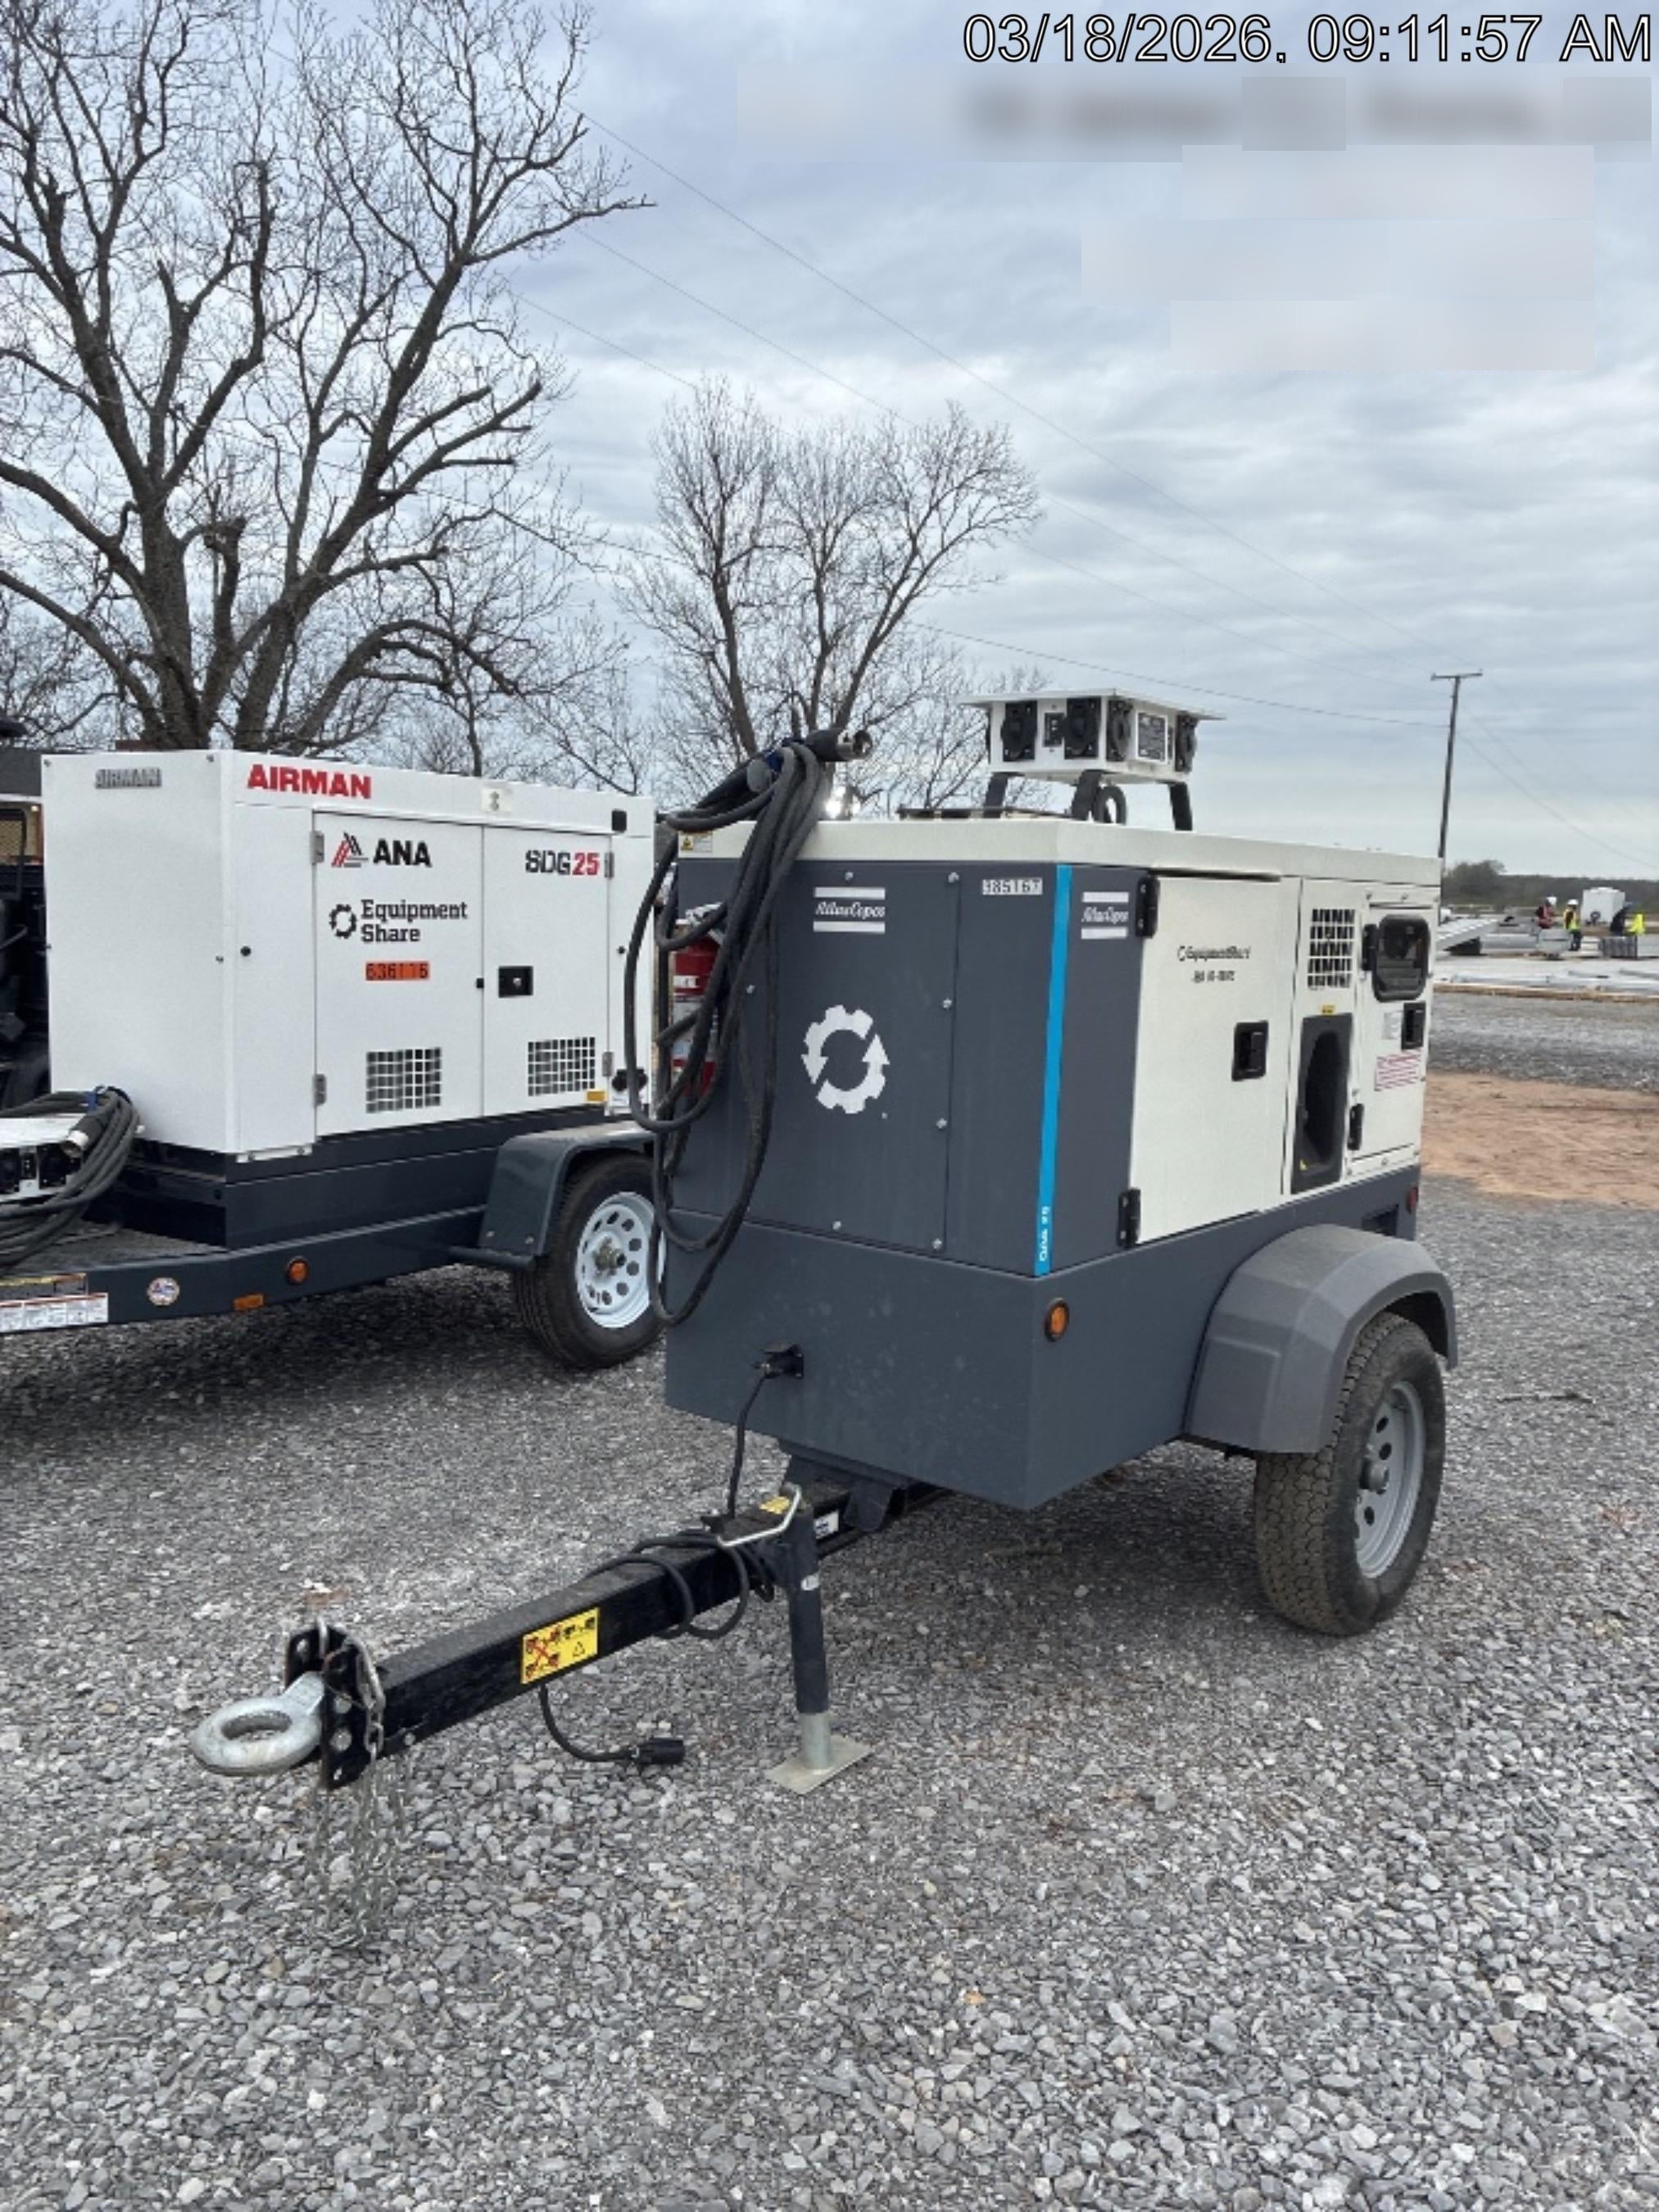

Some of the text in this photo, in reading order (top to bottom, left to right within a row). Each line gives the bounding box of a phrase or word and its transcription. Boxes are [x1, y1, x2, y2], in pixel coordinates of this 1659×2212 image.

[247, 764, 373, 800] AIRMAN
[373, 838, 433, 868] ANA
[360, 898, 468, 923] Equipment
[360, 922, 421, 943] Share
